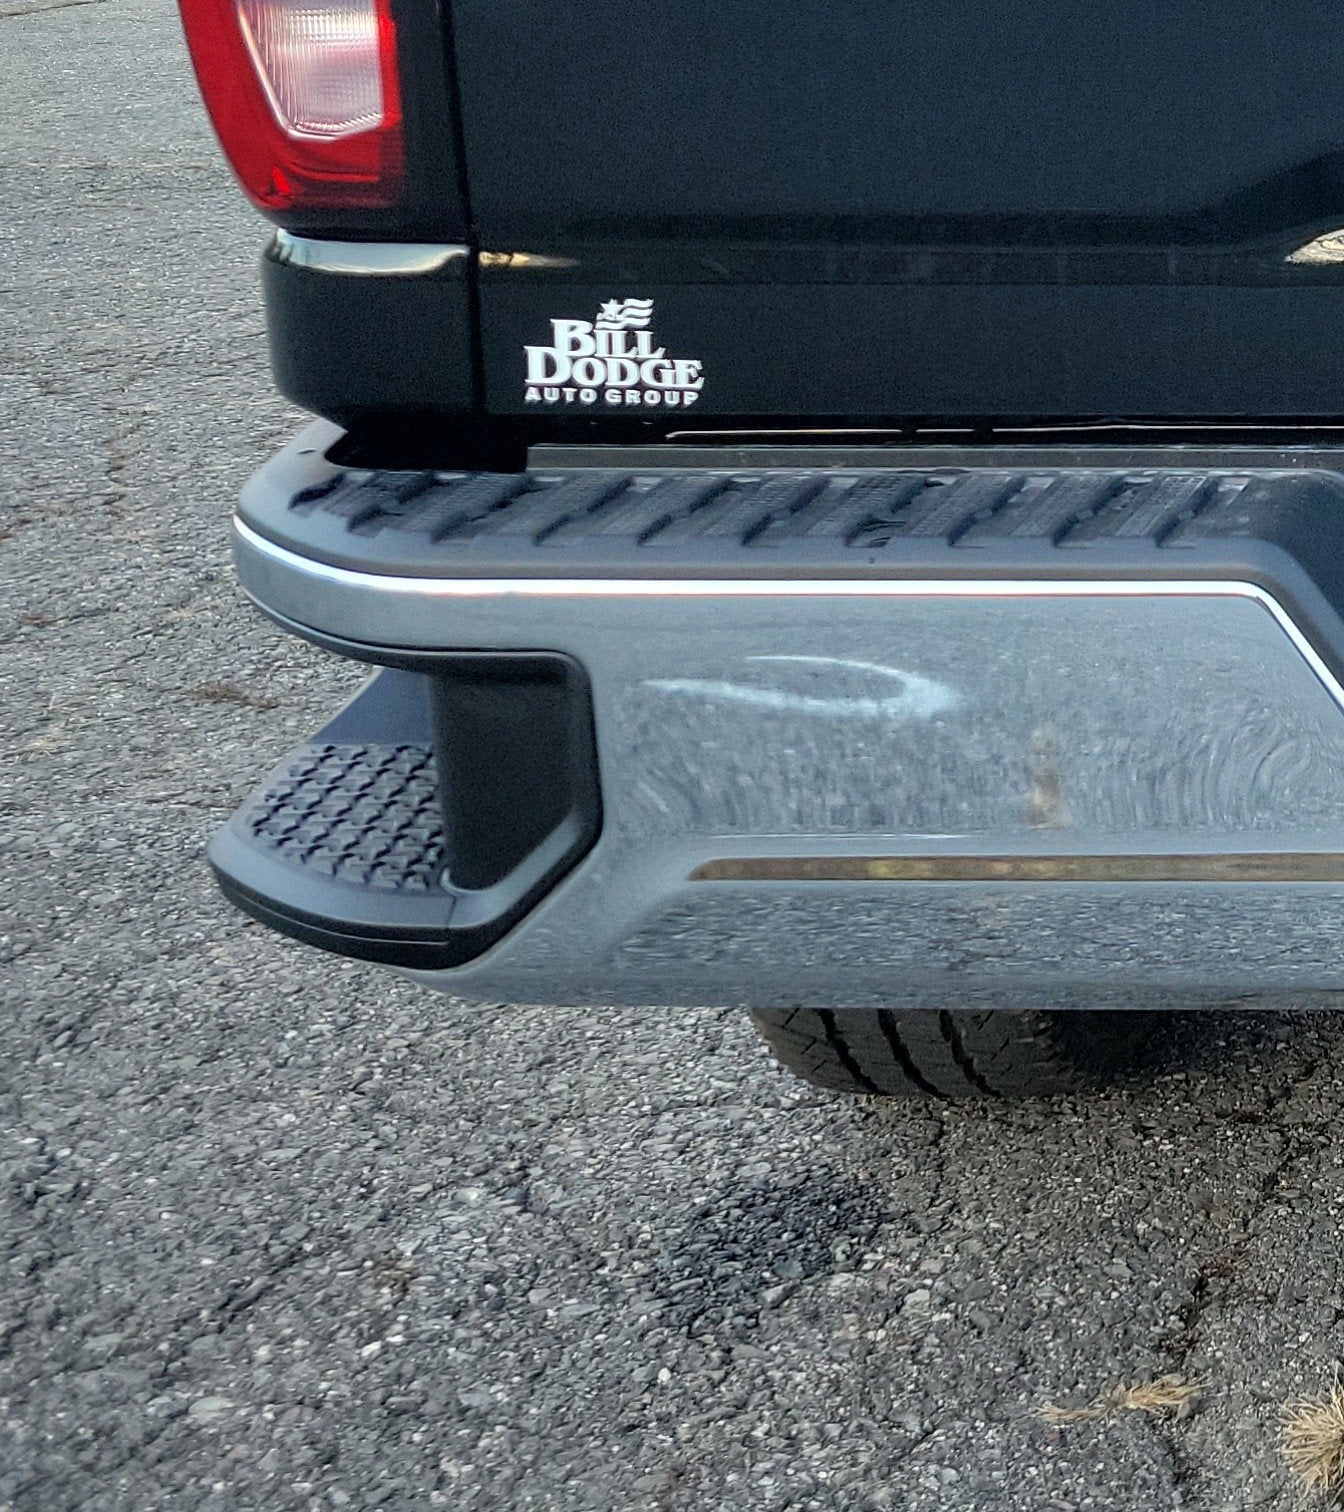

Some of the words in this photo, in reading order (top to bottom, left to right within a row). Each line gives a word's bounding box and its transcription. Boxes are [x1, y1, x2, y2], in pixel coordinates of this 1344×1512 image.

[550, 319, 666, 359] BILL
[523, 345, 705, 389] DODGE
[524, 387, 598, 404] AUTO
[605, 389, 699, 406] GROUP
